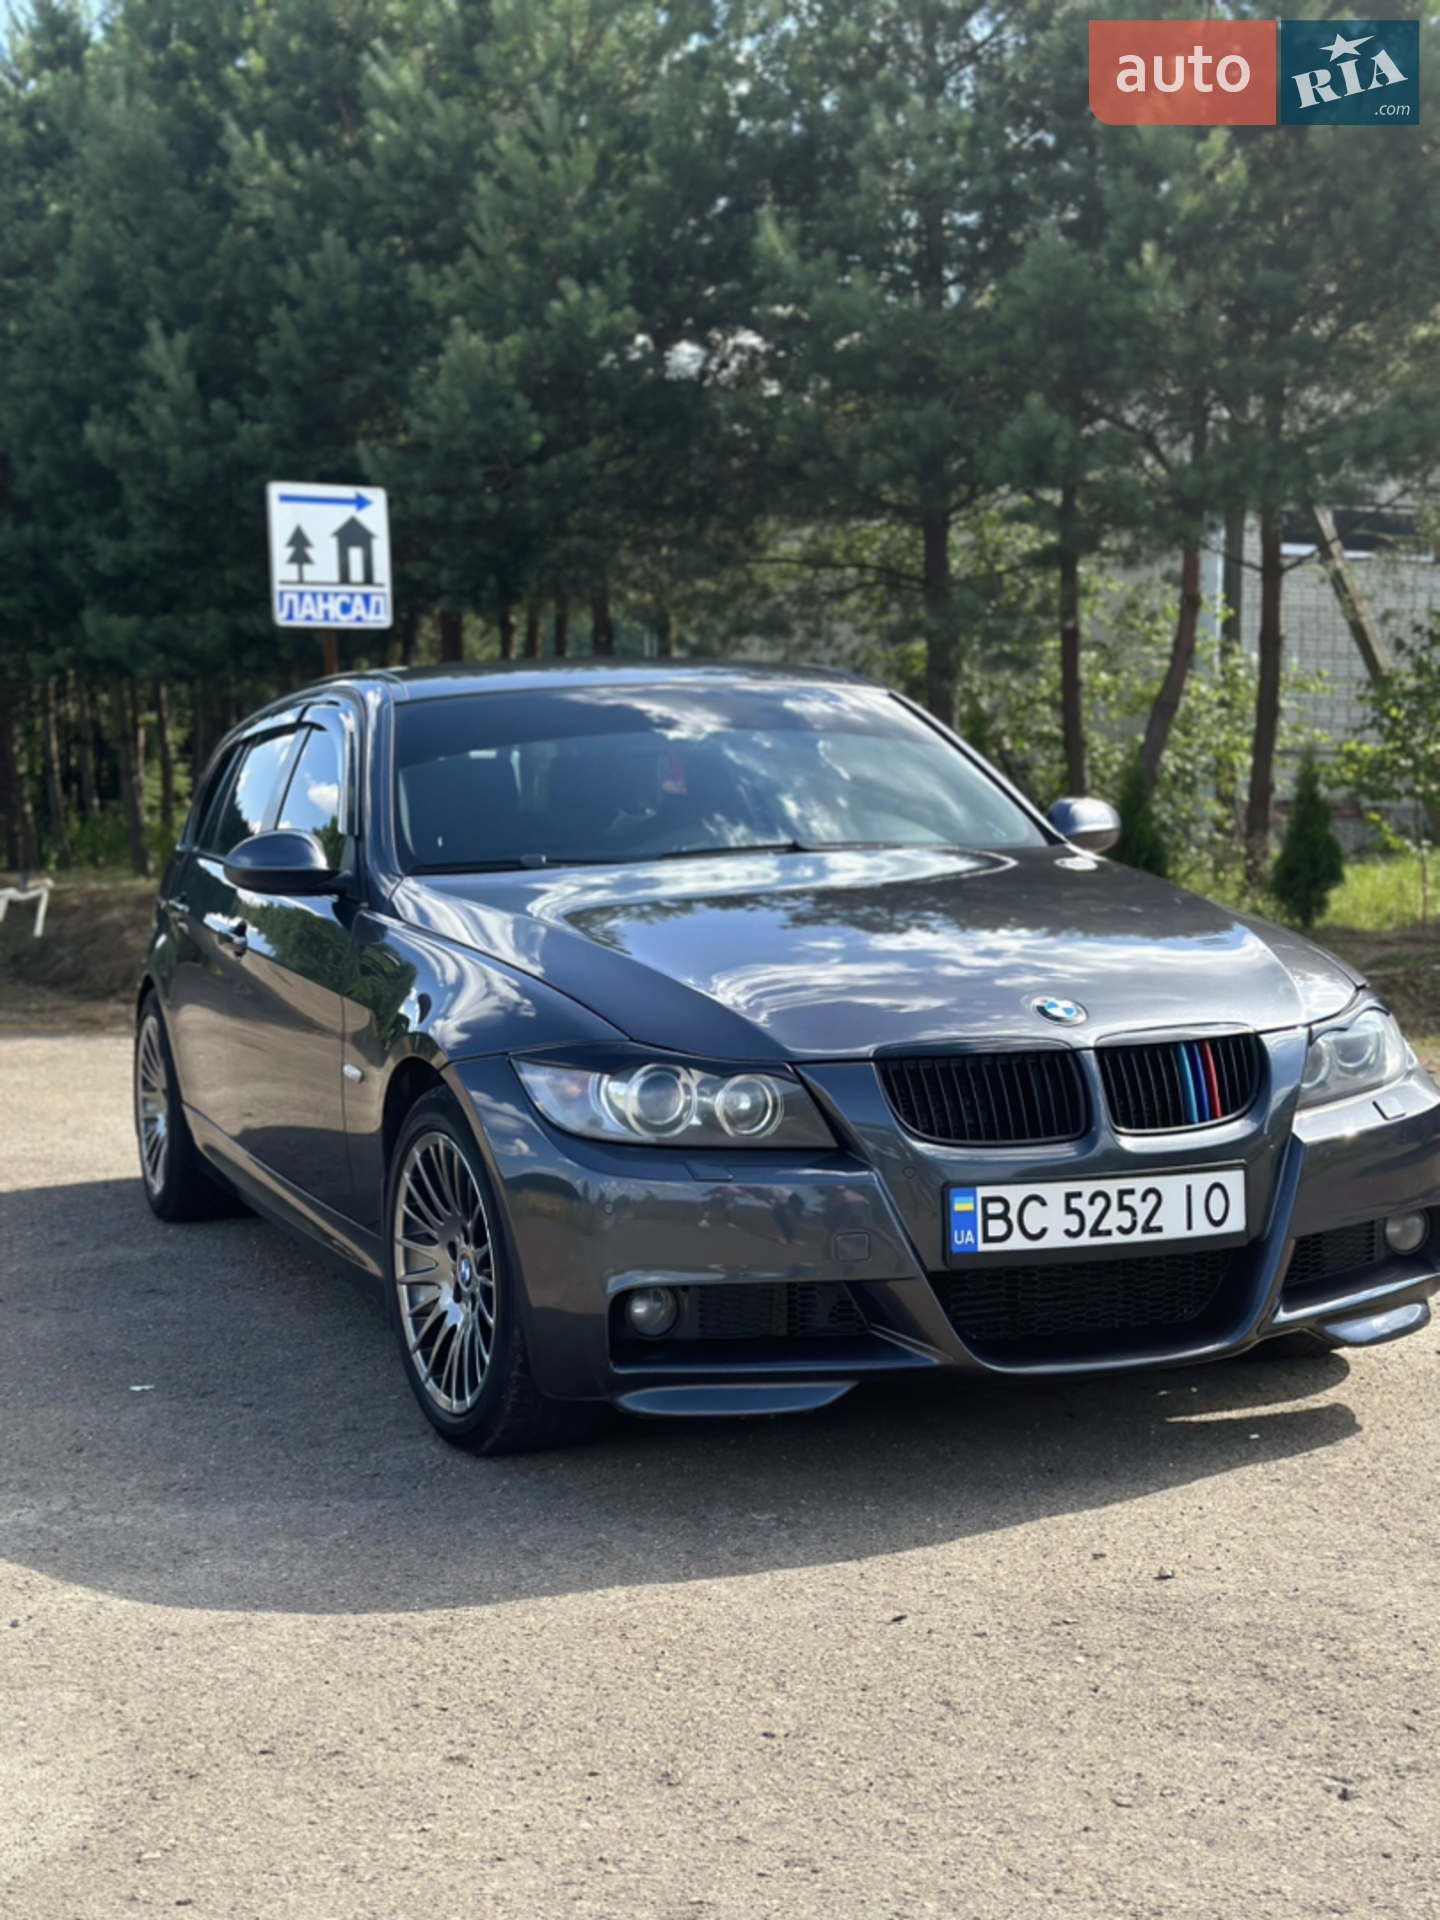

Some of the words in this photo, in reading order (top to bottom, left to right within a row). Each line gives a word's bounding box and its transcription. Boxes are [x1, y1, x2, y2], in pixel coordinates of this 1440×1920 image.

[278, 591, 388, 623] ЛАНСАД
[980, 1194, 1048, 1244] BC
[1063, 1187, 1163, 1238] 5252
[1185, 1181, 1230, 1231] IO
[954, 1230, 975, 1245] UA
